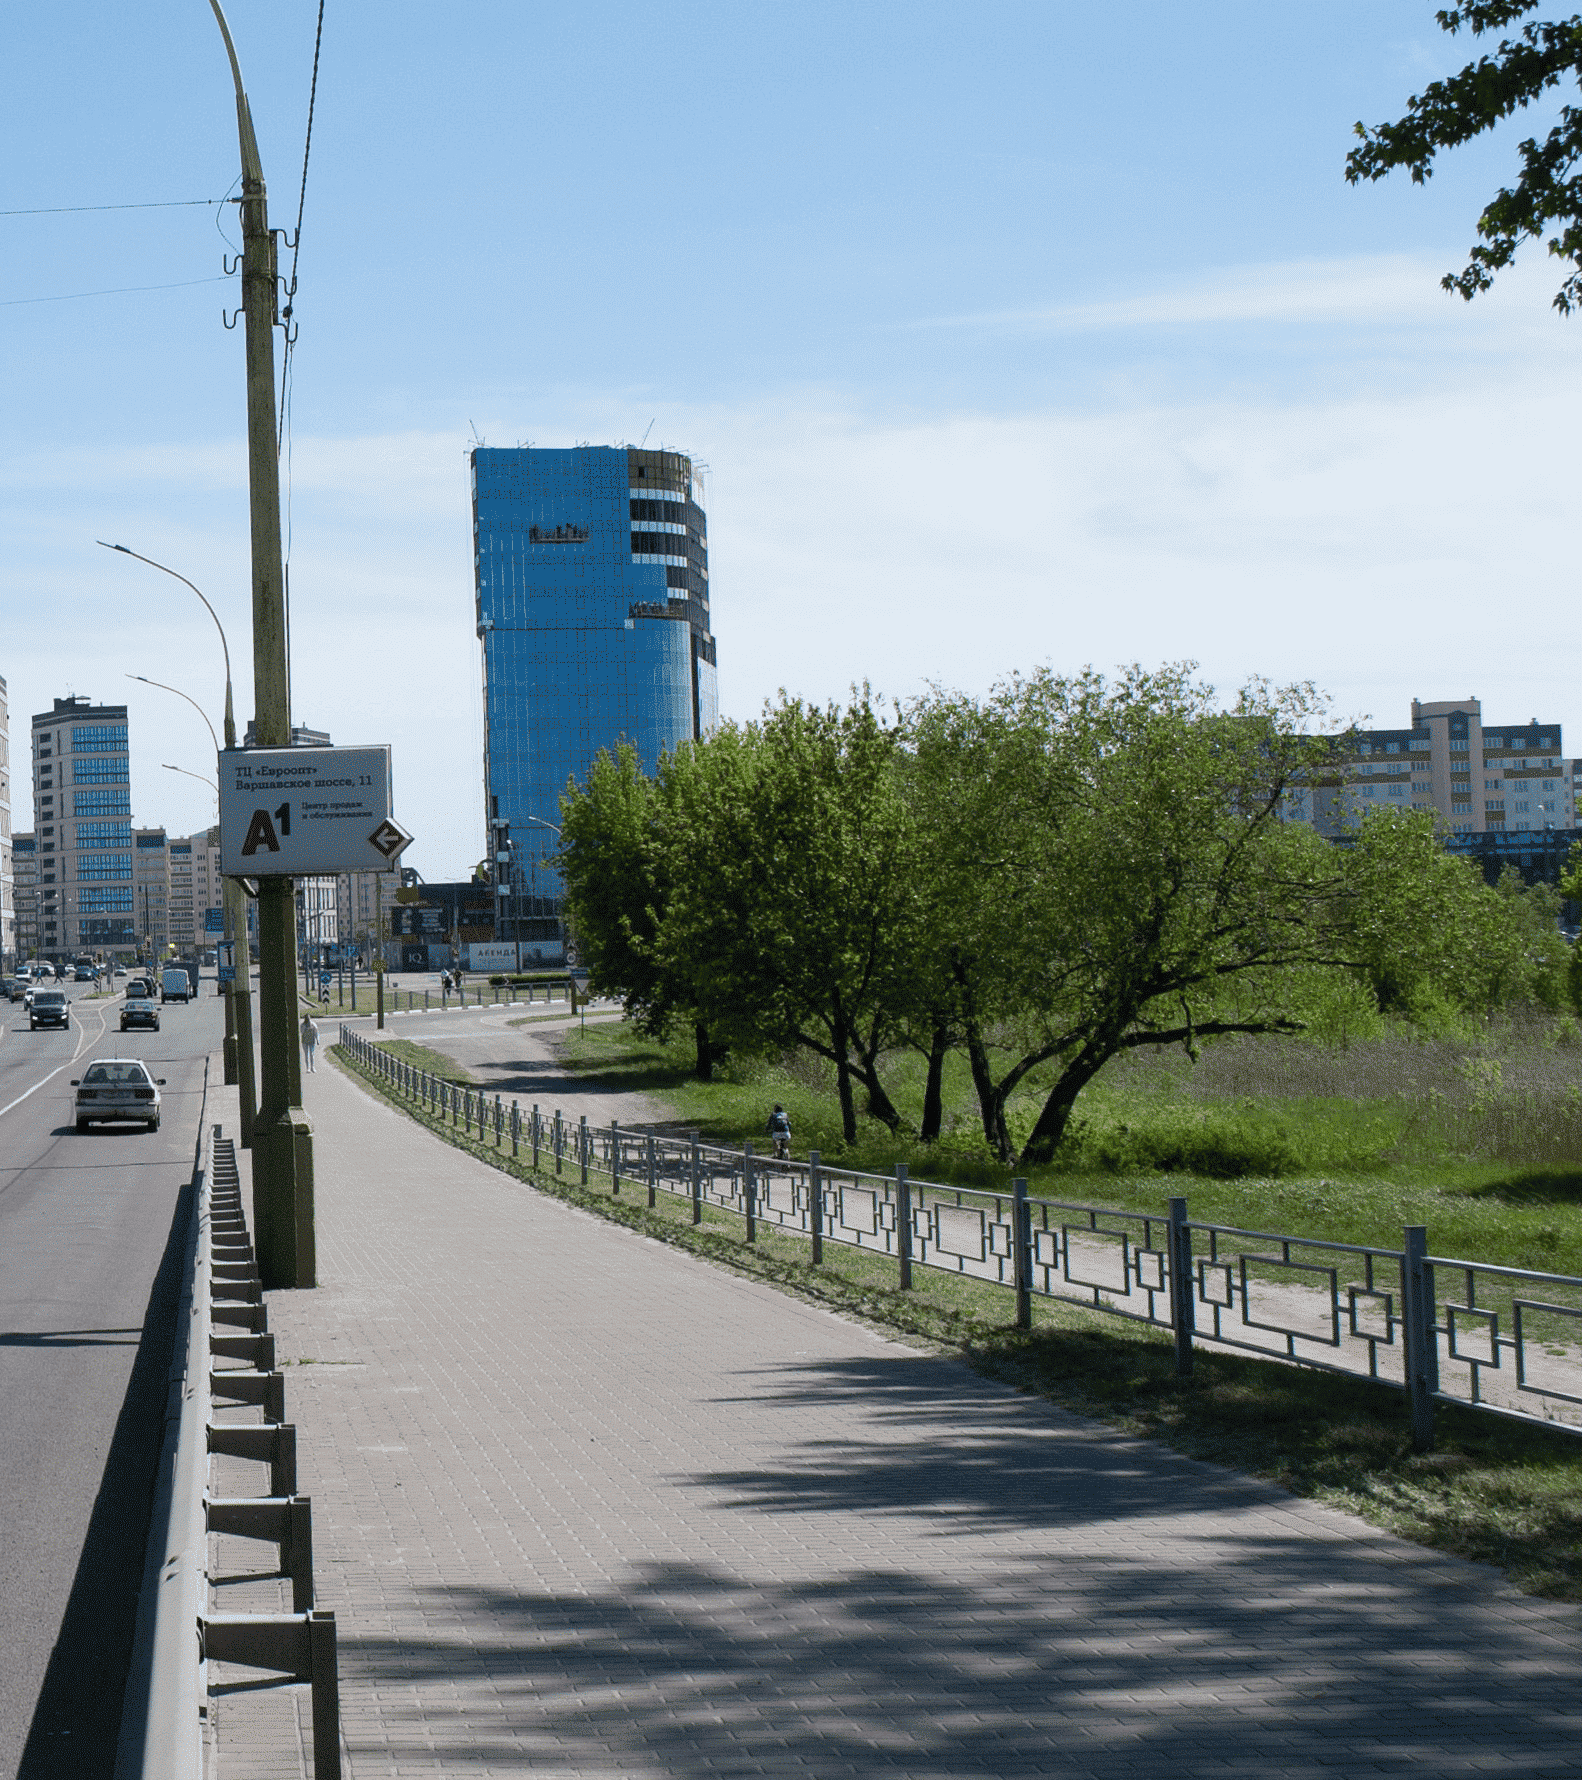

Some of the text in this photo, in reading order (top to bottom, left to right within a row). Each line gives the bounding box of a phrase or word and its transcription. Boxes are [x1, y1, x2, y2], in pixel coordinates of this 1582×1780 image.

[235, 765, 318, 778] ТЦ «Евроопт»
[235, 775, 373, 792] Варшавское шоссе, 11
[301, 802, 328, 811] Центр
[241, 802, 291, 856] A1
